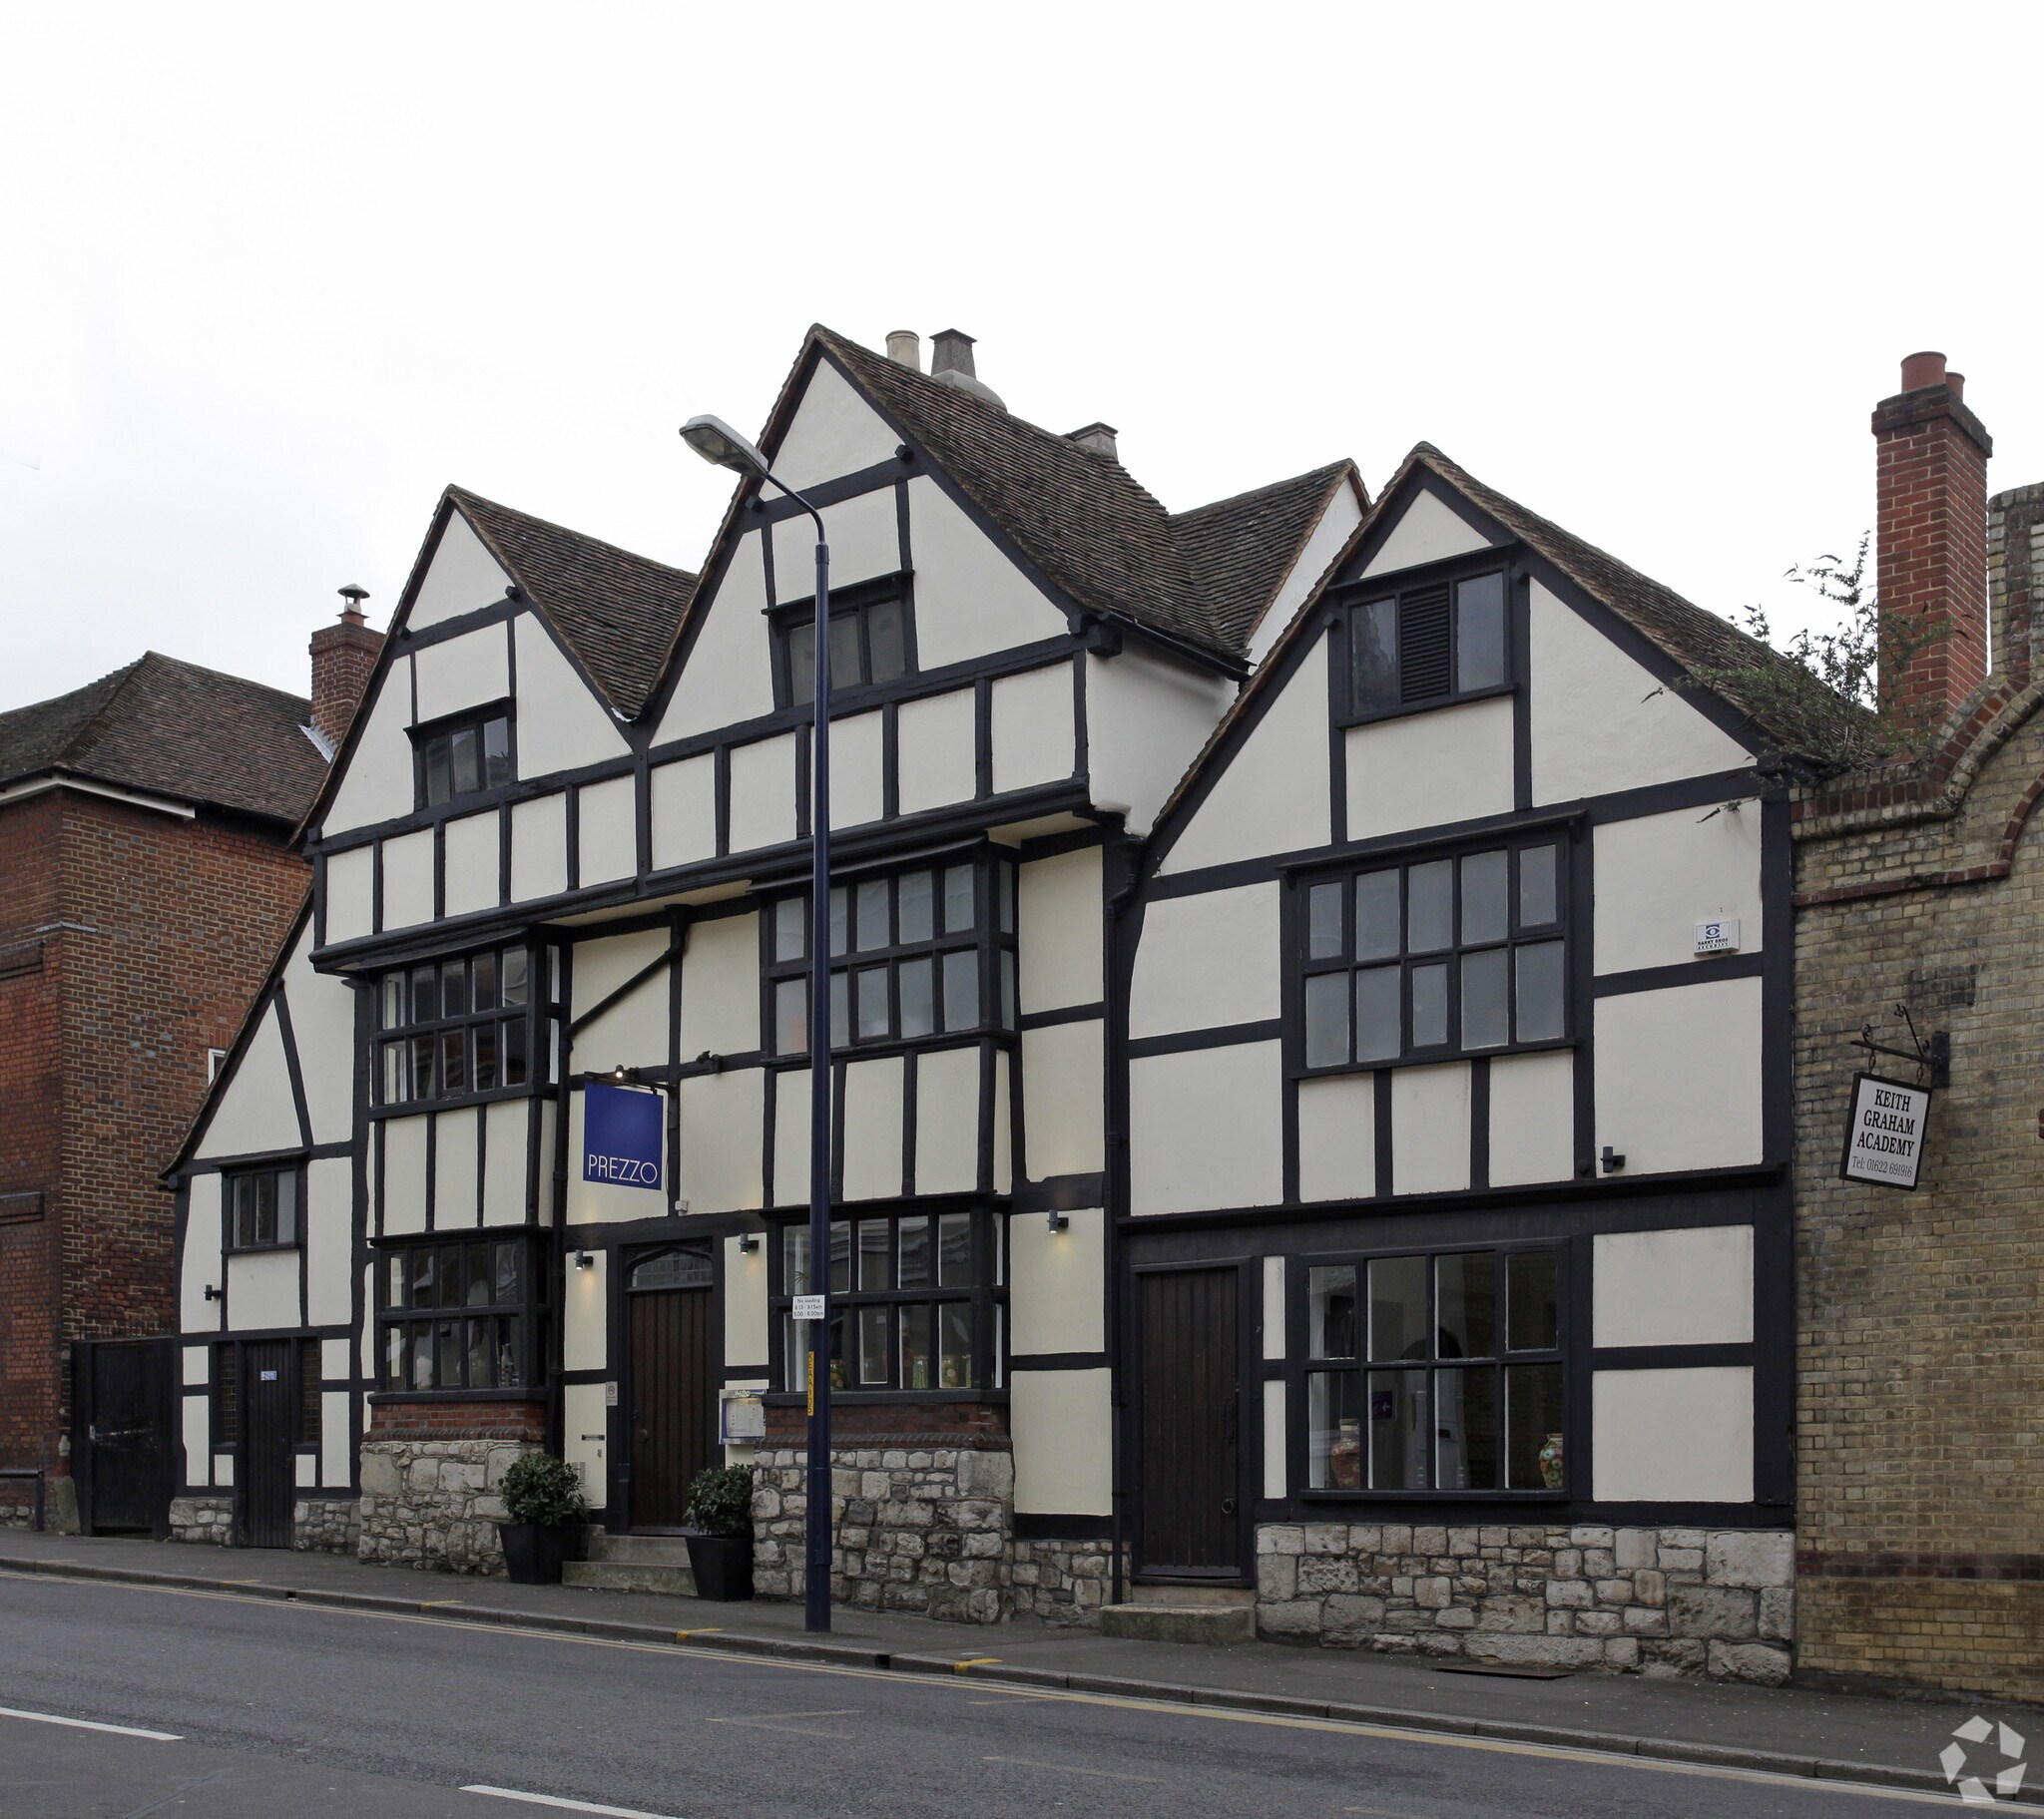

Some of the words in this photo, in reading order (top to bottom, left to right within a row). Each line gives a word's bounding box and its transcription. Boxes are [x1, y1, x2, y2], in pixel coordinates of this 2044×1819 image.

[1874, 1089, 1911, 1113] KEITH
[1863, 1110, 1915, 1136] GRAHAM
[1856, 1132, 1915, 1157] ACADEMY
[588, 1153, 658, 1184] PREZZO
[1852, 1155, 1865, 1169] Tel:
[1866, 1157, 1888, 1173] 01622
[1889, 1162, 1913, 1177] 691916
